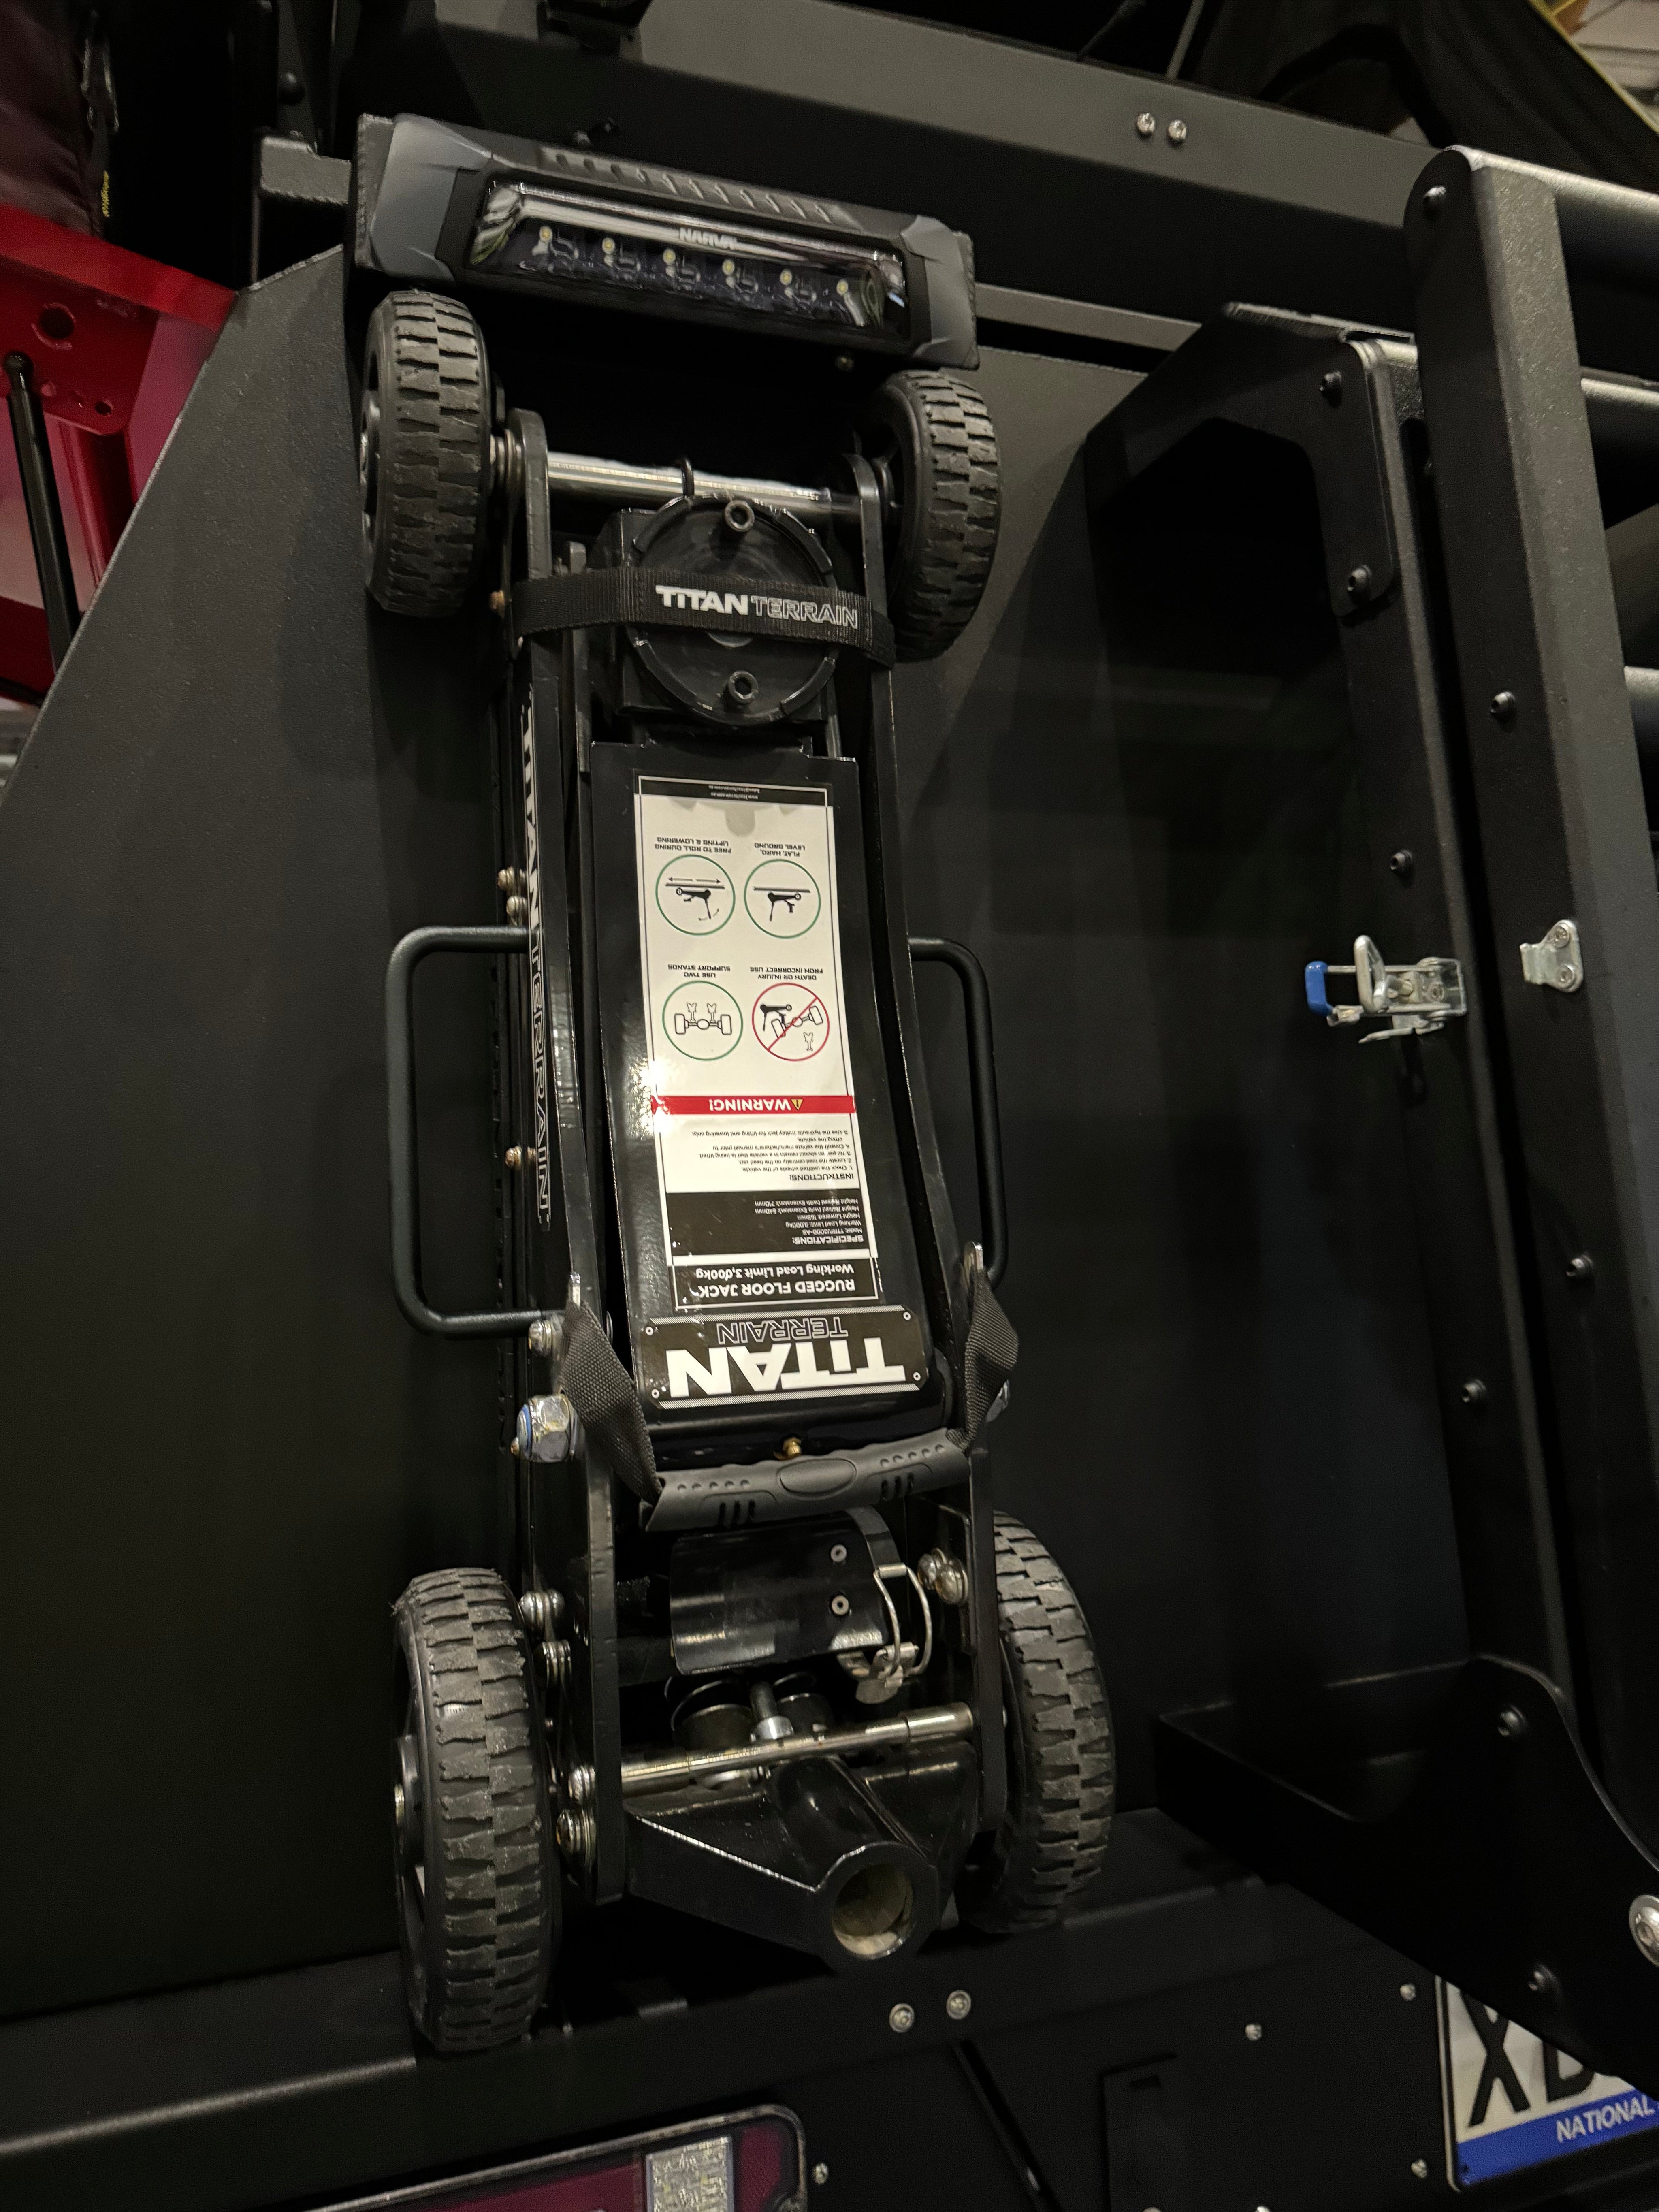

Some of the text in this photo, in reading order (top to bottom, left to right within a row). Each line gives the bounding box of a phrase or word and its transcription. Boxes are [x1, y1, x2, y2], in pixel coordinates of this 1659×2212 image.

[655, 585, 857, 629] TITAN TERRAIN
[709, 1099, 791, 1111] WARNING!
[792, 1235, 864, 1245] SPECIFICATIONS:
[696, 1263, 854, 1281] Working Load Limit 3,000kg
[697, 1279, 855, 1298] RUGGED FLOOR JACK
[716, 1317, 848, 1344] TERRAIN
[666, 1337, 906, 1397] TITAN
[1556, 2095, 1655, 2143] NATIONAL
